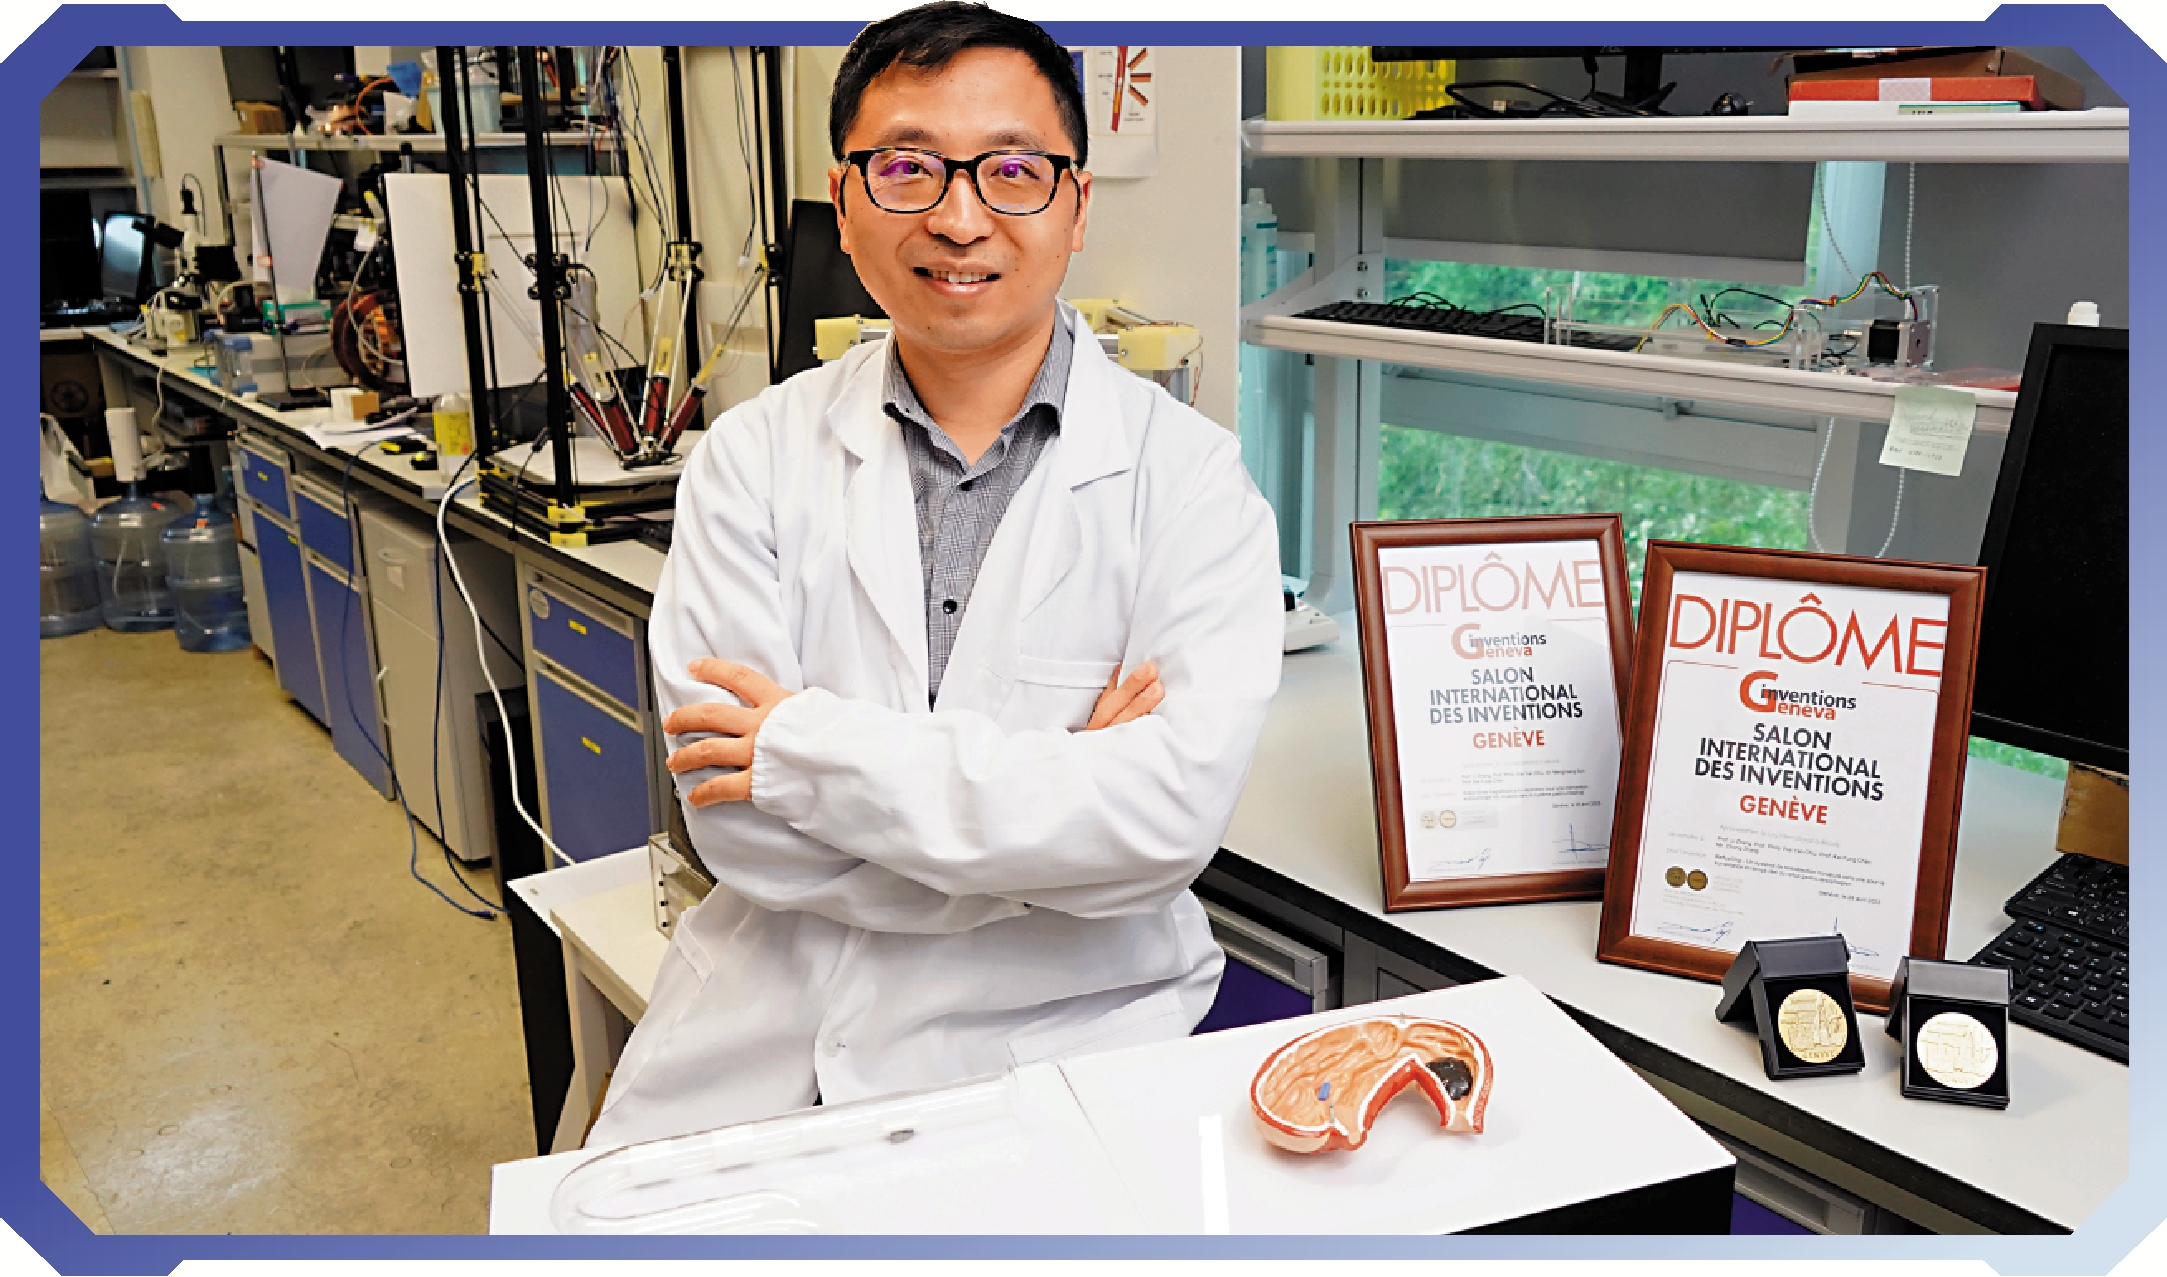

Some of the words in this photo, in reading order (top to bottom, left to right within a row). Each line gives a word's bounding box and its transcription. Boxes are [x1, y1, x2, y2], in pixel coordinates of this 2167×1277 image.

[1382, 551, 1605, 615] DIPLÔME
[1451, 622, 1533, 660] Geneva
[1468, 631, 1547, 648] inventions
[1669, 591, 1948, 678] DIPLÔME
[1471, 666, 1534, 686] SALON
[1430, 684, 1578, 705] INTERNATIONAL
[1739, 670, 1836, 721] Geneva
[1760, 684, 1857, 710] inventions
[1430, 706, 1464, 725] DES
[1468, 702, 1583, 723] INVENTIONS
[1472, 726, 1546, 749] GENÈVE
[1753, 722, 1832, 750] SALON
[1700, 737, 1881, 779] INTERNATIONAL
[1694, 757, 1735, 781] DES
[1740, 764, 1885, 801] INVENTIONS
[1739, 794, 1829, 826] GENÈVE
